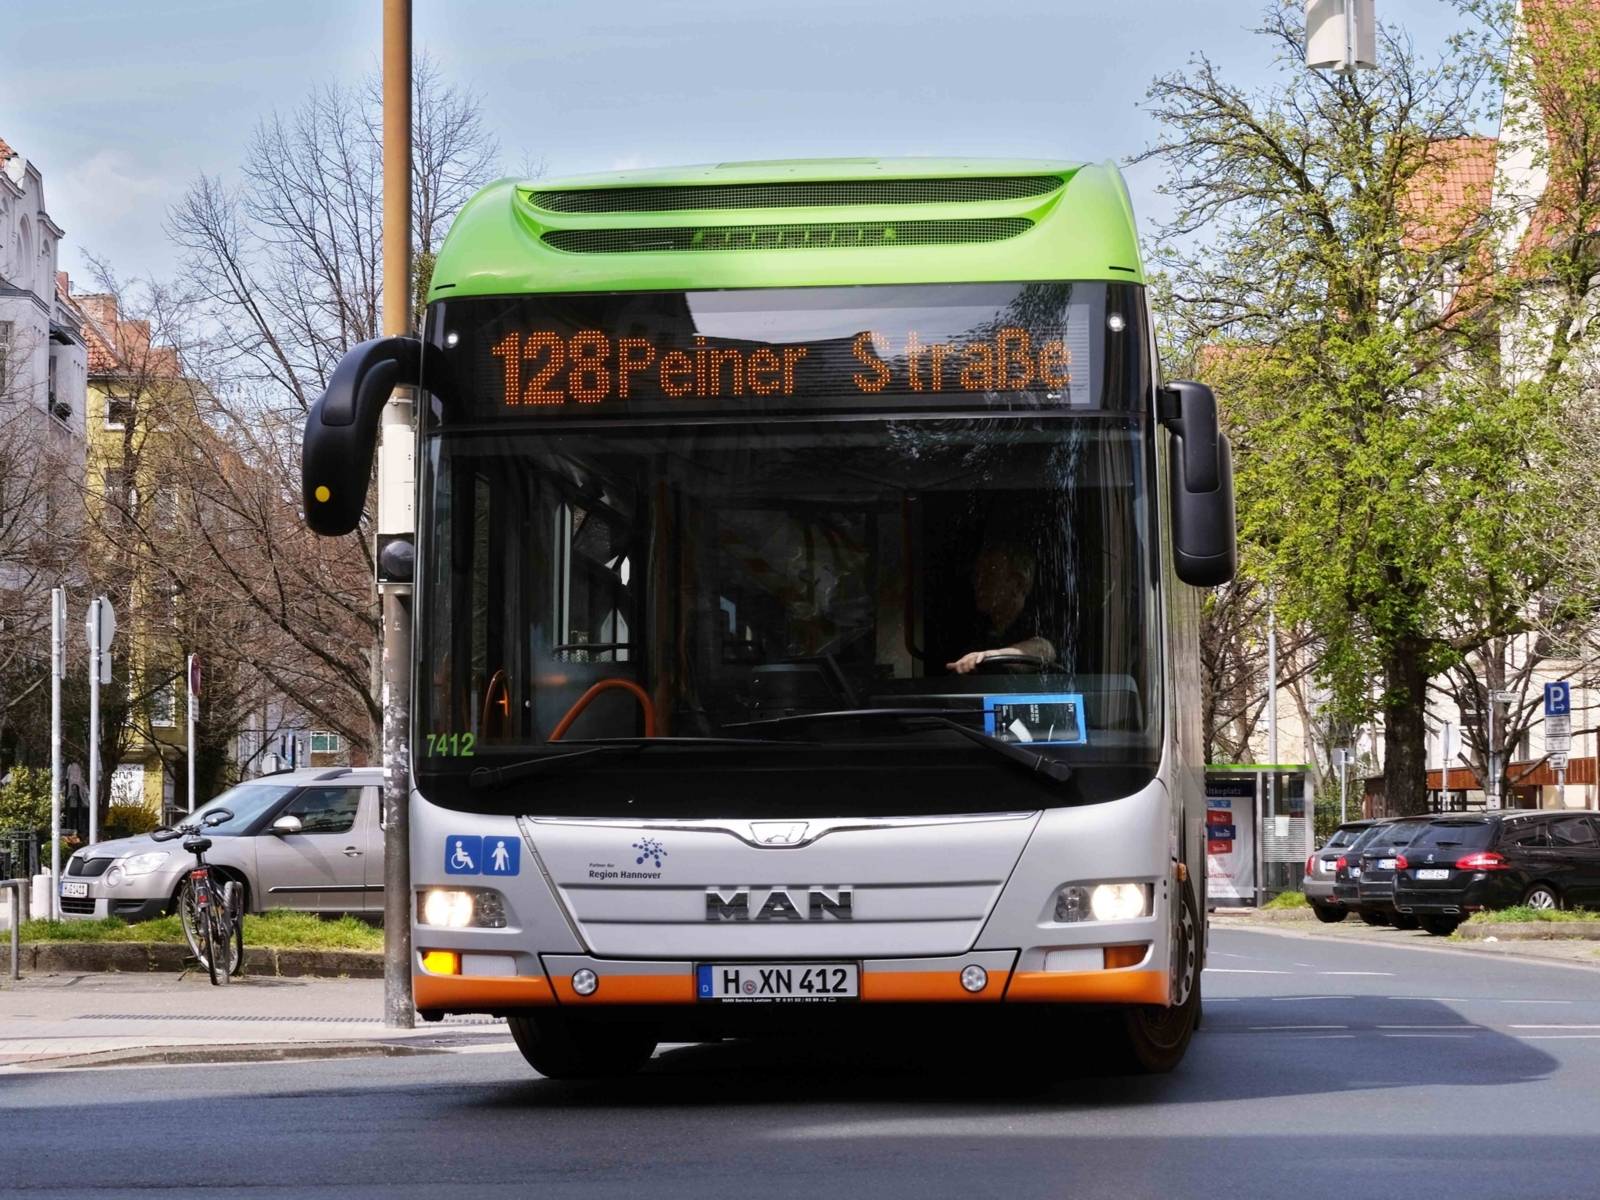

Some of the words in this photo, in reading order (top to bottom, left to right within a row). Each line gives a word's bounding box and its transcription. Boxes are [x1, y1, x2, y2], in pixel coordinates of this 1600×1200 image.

[492, 330, 610, 405] 128
[618, 335, 807, 397] Peiner
[852, 327, 1072, 392] Straße
[1549, 686, 1564, 712] P
[426, 732, 474, 758] 7412
[588, 870, 619, 881] Region
[620, 870, 662, 880] Hannover
[705, 885, 853, 921] MAN
[702, 985, 709, 993] D
[723, 969, 740, 994] H
[759, 969, 792, 994] XN
[799, 968, 848, 994] 412
